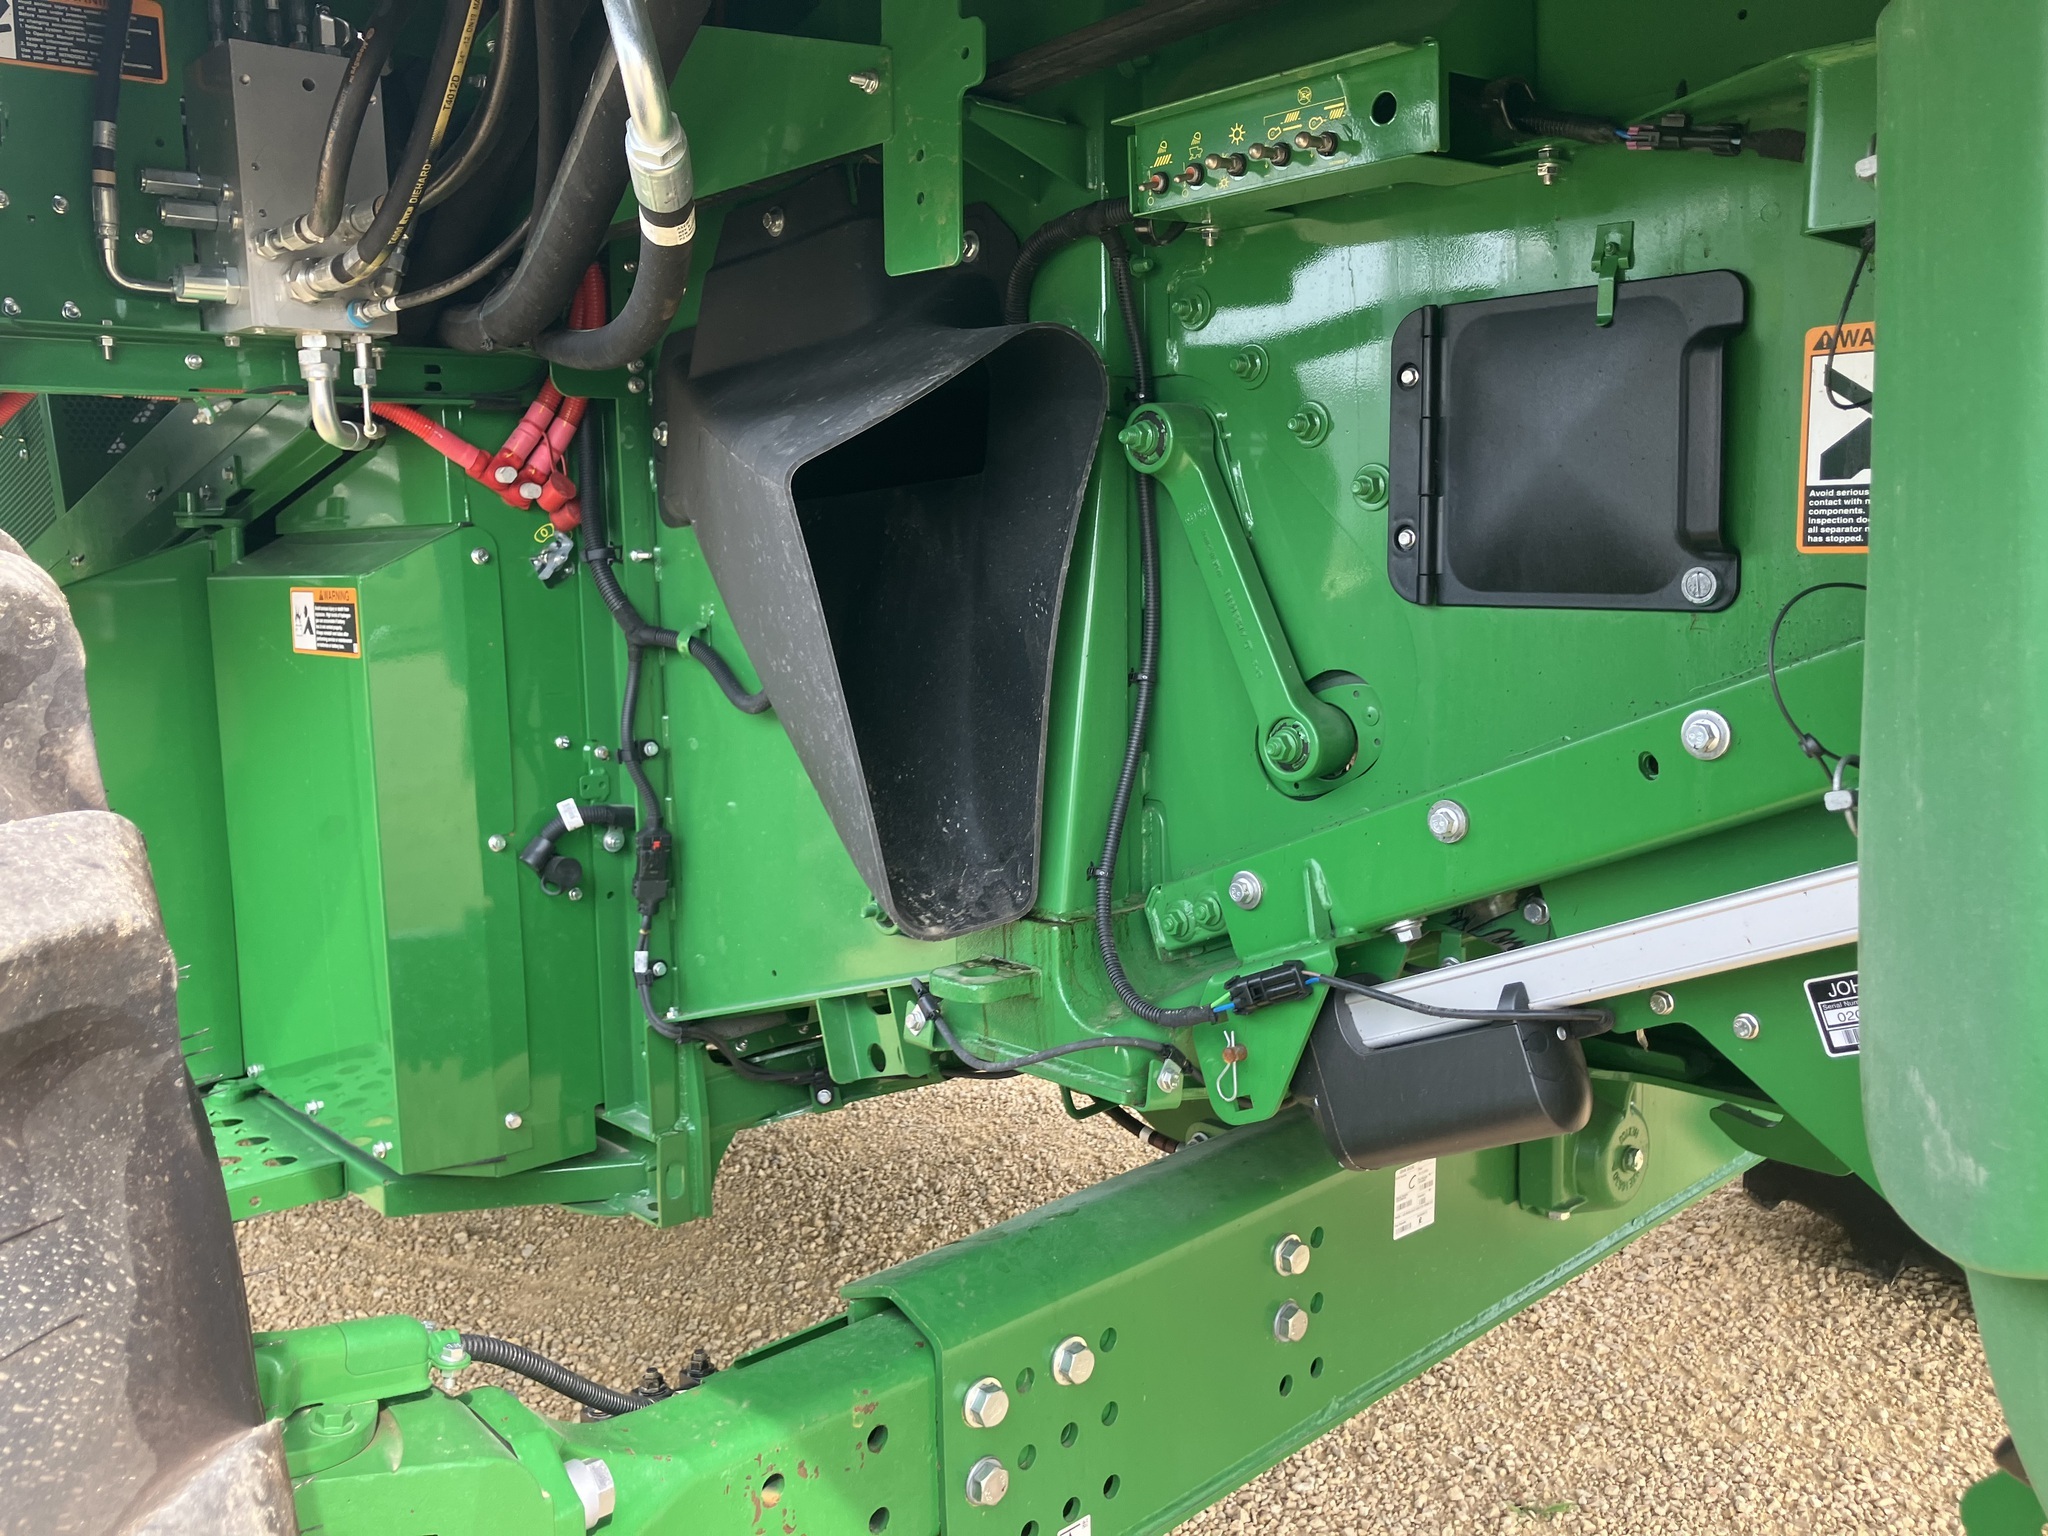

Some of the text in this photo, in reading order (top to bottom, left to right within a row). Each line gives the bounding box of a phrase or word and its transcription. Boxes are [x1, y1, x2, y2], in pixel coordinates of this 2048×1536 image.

[442, 74, 460, 112] T4012D
[1808, 508, 1866, 516] components.
[1808, 517, 1854, 525] Inspection
[1825, 535, 1864, 543] stopped.
[1822, 1002, 1842, 1010] Serial
